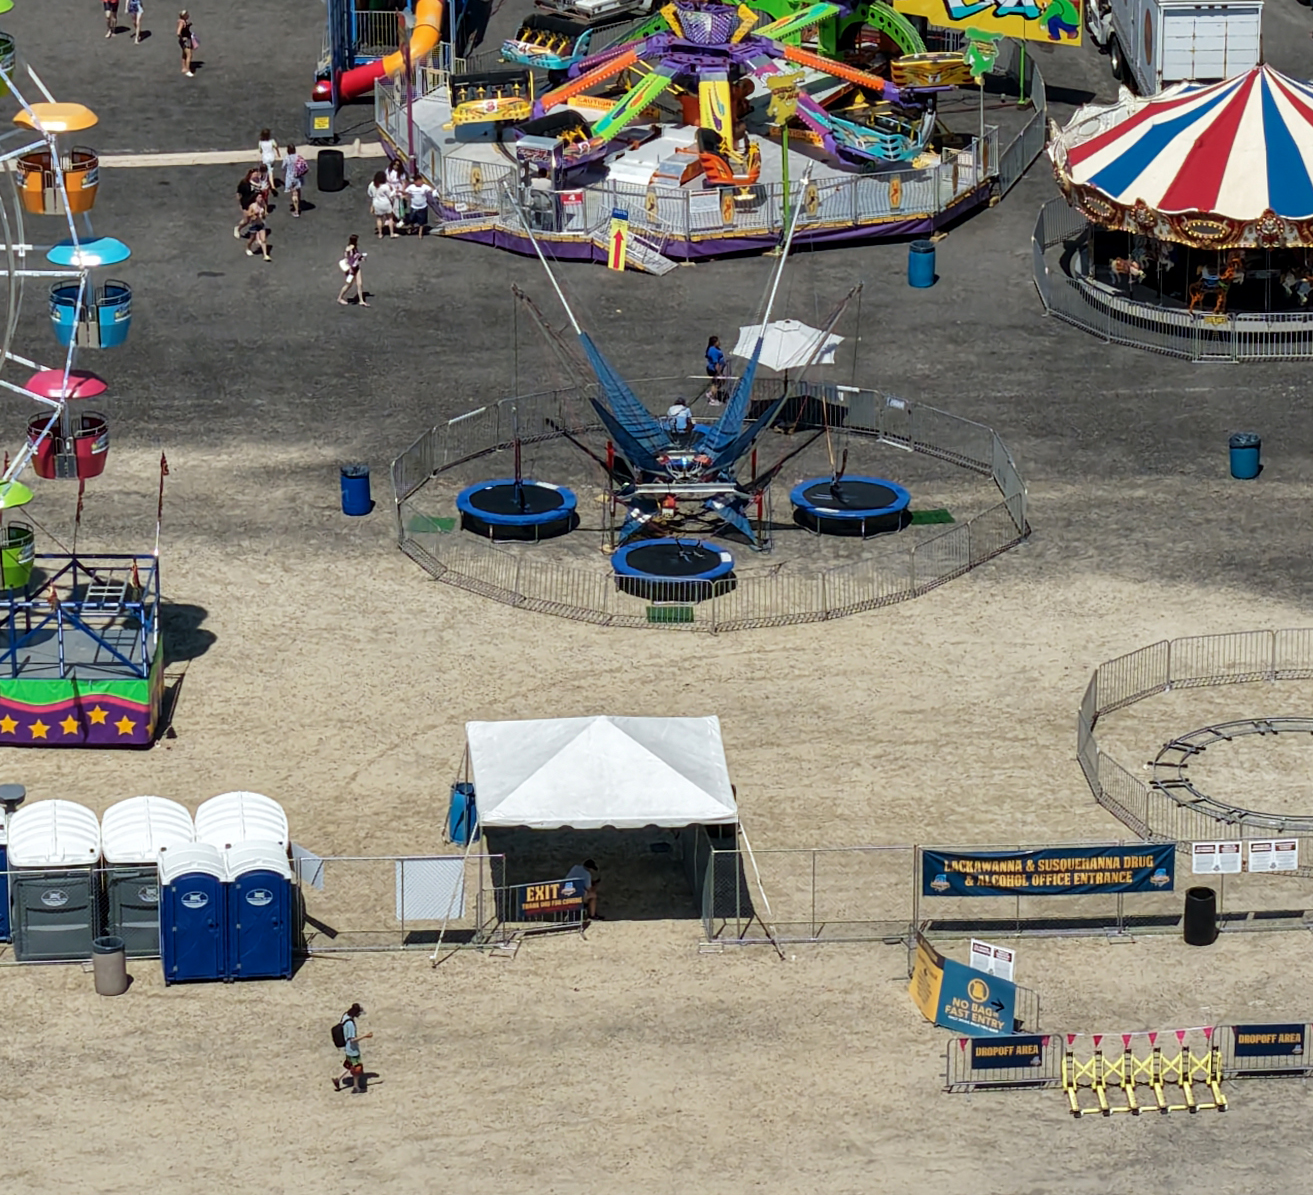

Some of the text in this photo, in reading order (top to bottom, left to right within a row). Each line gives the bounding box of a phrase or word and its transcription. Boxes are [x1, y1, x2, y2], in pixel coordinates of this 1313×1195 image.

[944, 855, 1154, 873] LACKAWANNA & SUSQUEHANNA DRUG
[964, 871, 1133, 887] & ALCOHOL OFFICE ENTRANCE
[527, 883, 560, 902] EXIT
[952, 996, 969, 1010] NO
[944, 1005, 970, 1019] FAST
[971, 1012, 1005, 1030] ENTRY
[1238, 1032, 1301, 1044] DROPOFF AREA
[975, 1044, 1039, 1057] DROPOFF AREA
